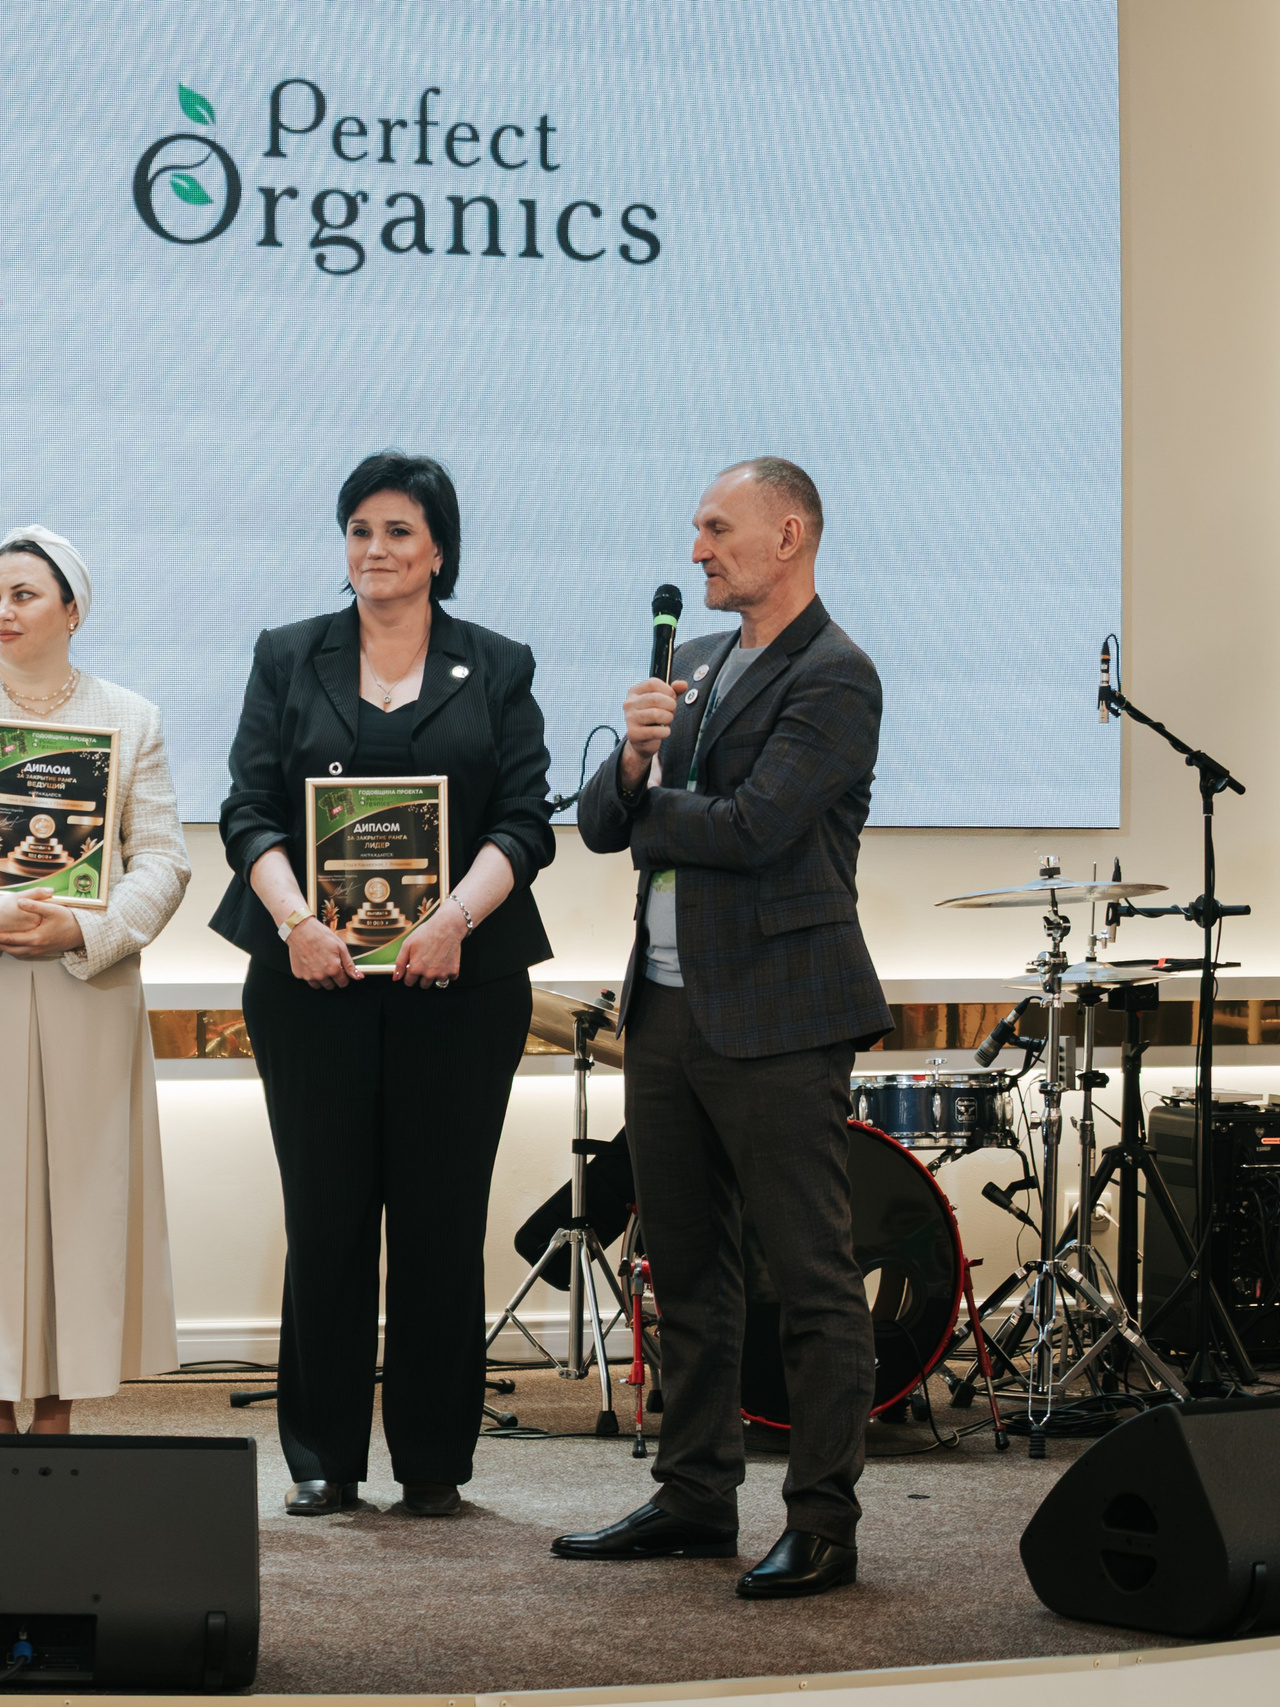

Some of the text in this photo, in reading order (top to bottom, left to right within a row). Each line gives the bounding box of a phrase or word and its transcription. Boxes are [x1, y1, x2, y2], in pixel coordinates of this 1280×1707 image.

[262, 78, 561, 172] Perfect
[132, 133, 661, 276] Organics
[32, 732, 97, 743] ГОДОВЩИНА ПРОЕКТА
[23, 763, 71, 775] ДИПЛОМ
[27, 781, 66, 790] ВЕДУЩИЙ
[57, 776, 77, 784] РАНГА
[353, 823, 400, 833] ДИПЛОМ
